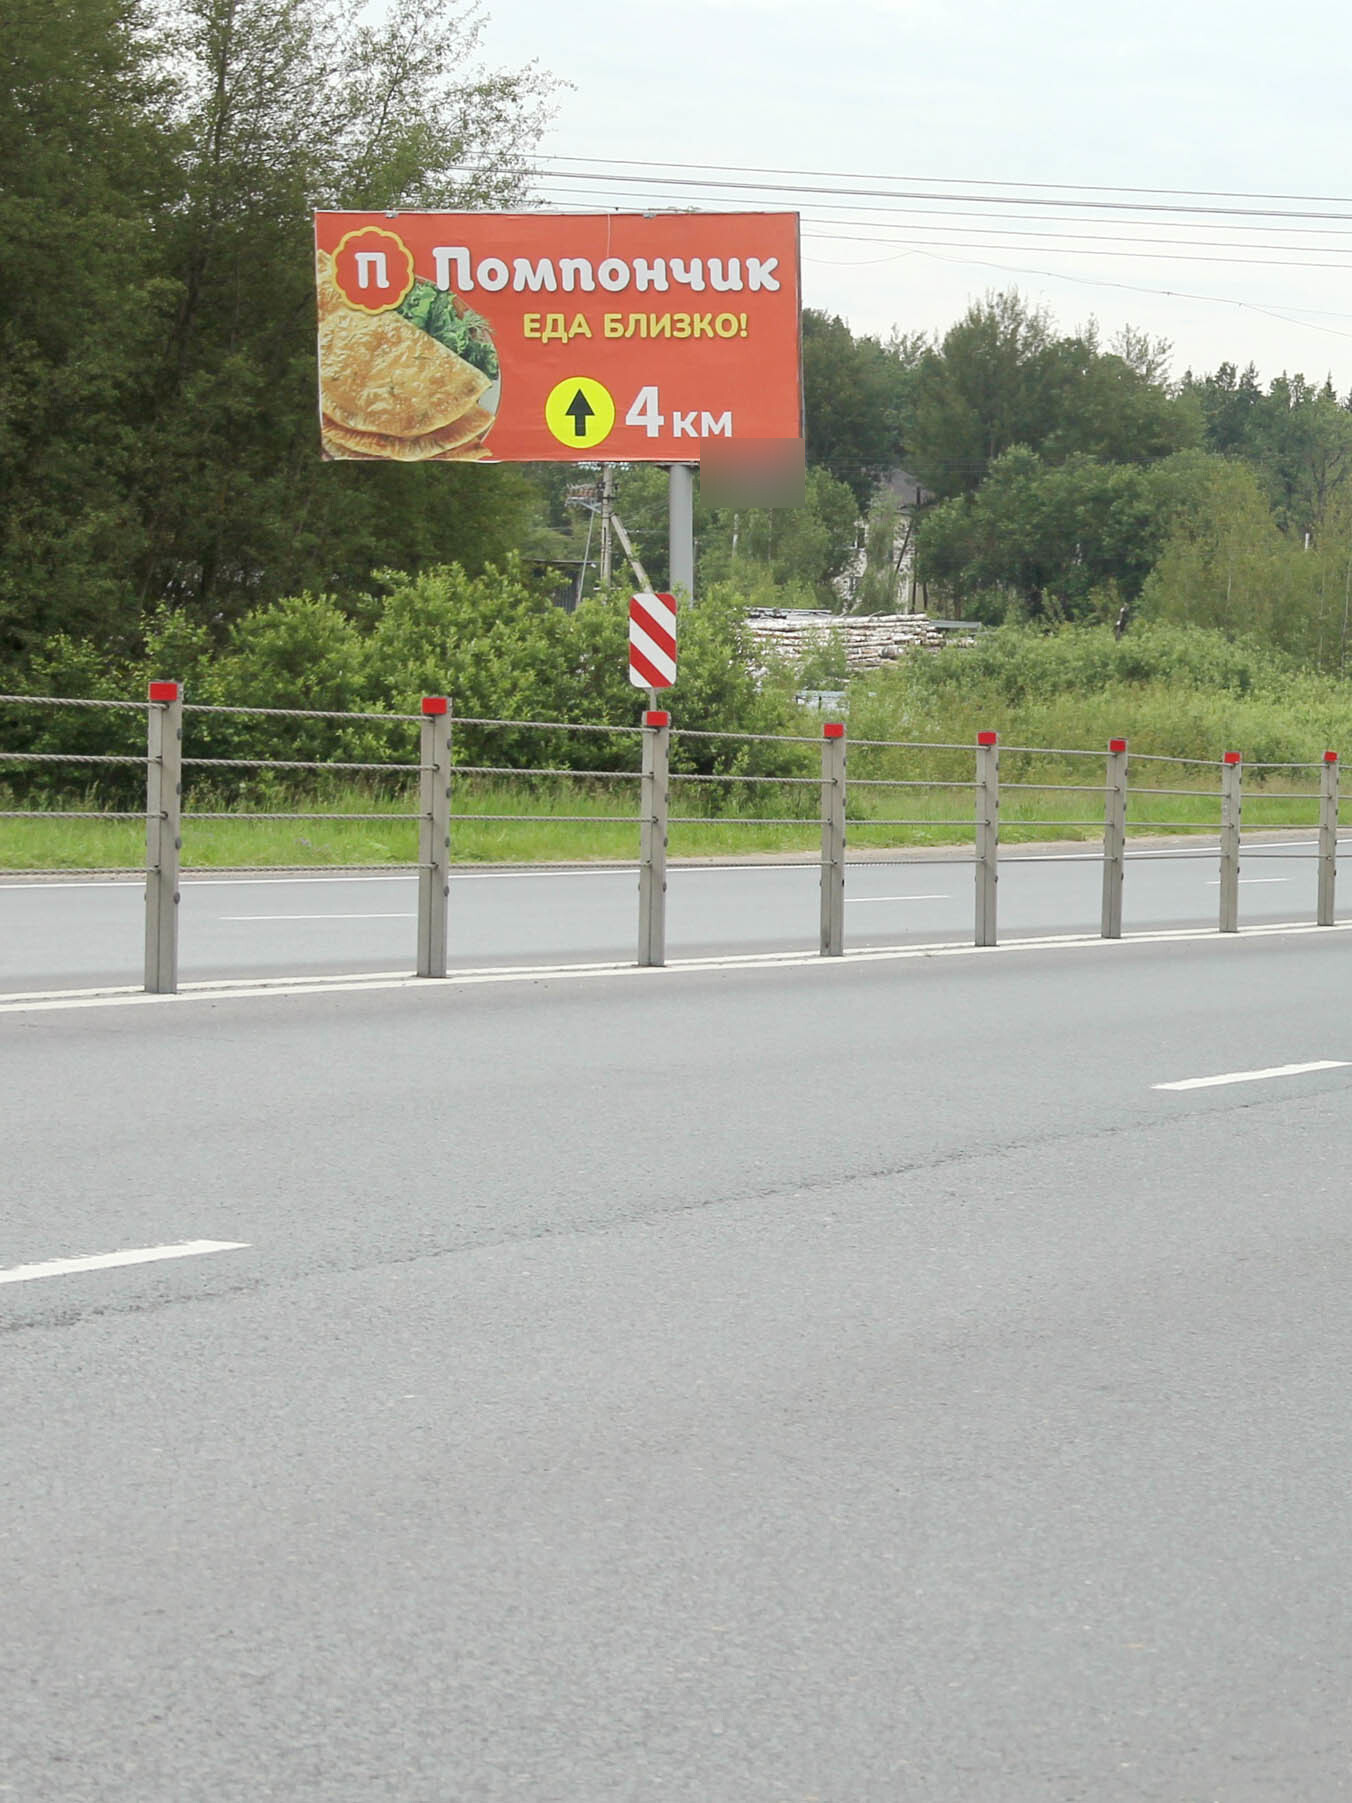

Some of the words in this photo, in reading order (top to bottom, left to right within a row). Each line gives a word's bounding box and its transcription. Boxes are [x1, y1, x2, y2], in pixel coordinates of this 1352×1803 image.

[354, 251, 390, 289] П
[432, 246, 781, 292] Помпончик
[523, 312, 593, 344] ЕДА
[603, 312, 749, 338] БЛИЗКО!
[625, 385, 665, 438] 4
[672, 411, 733, 438] км
